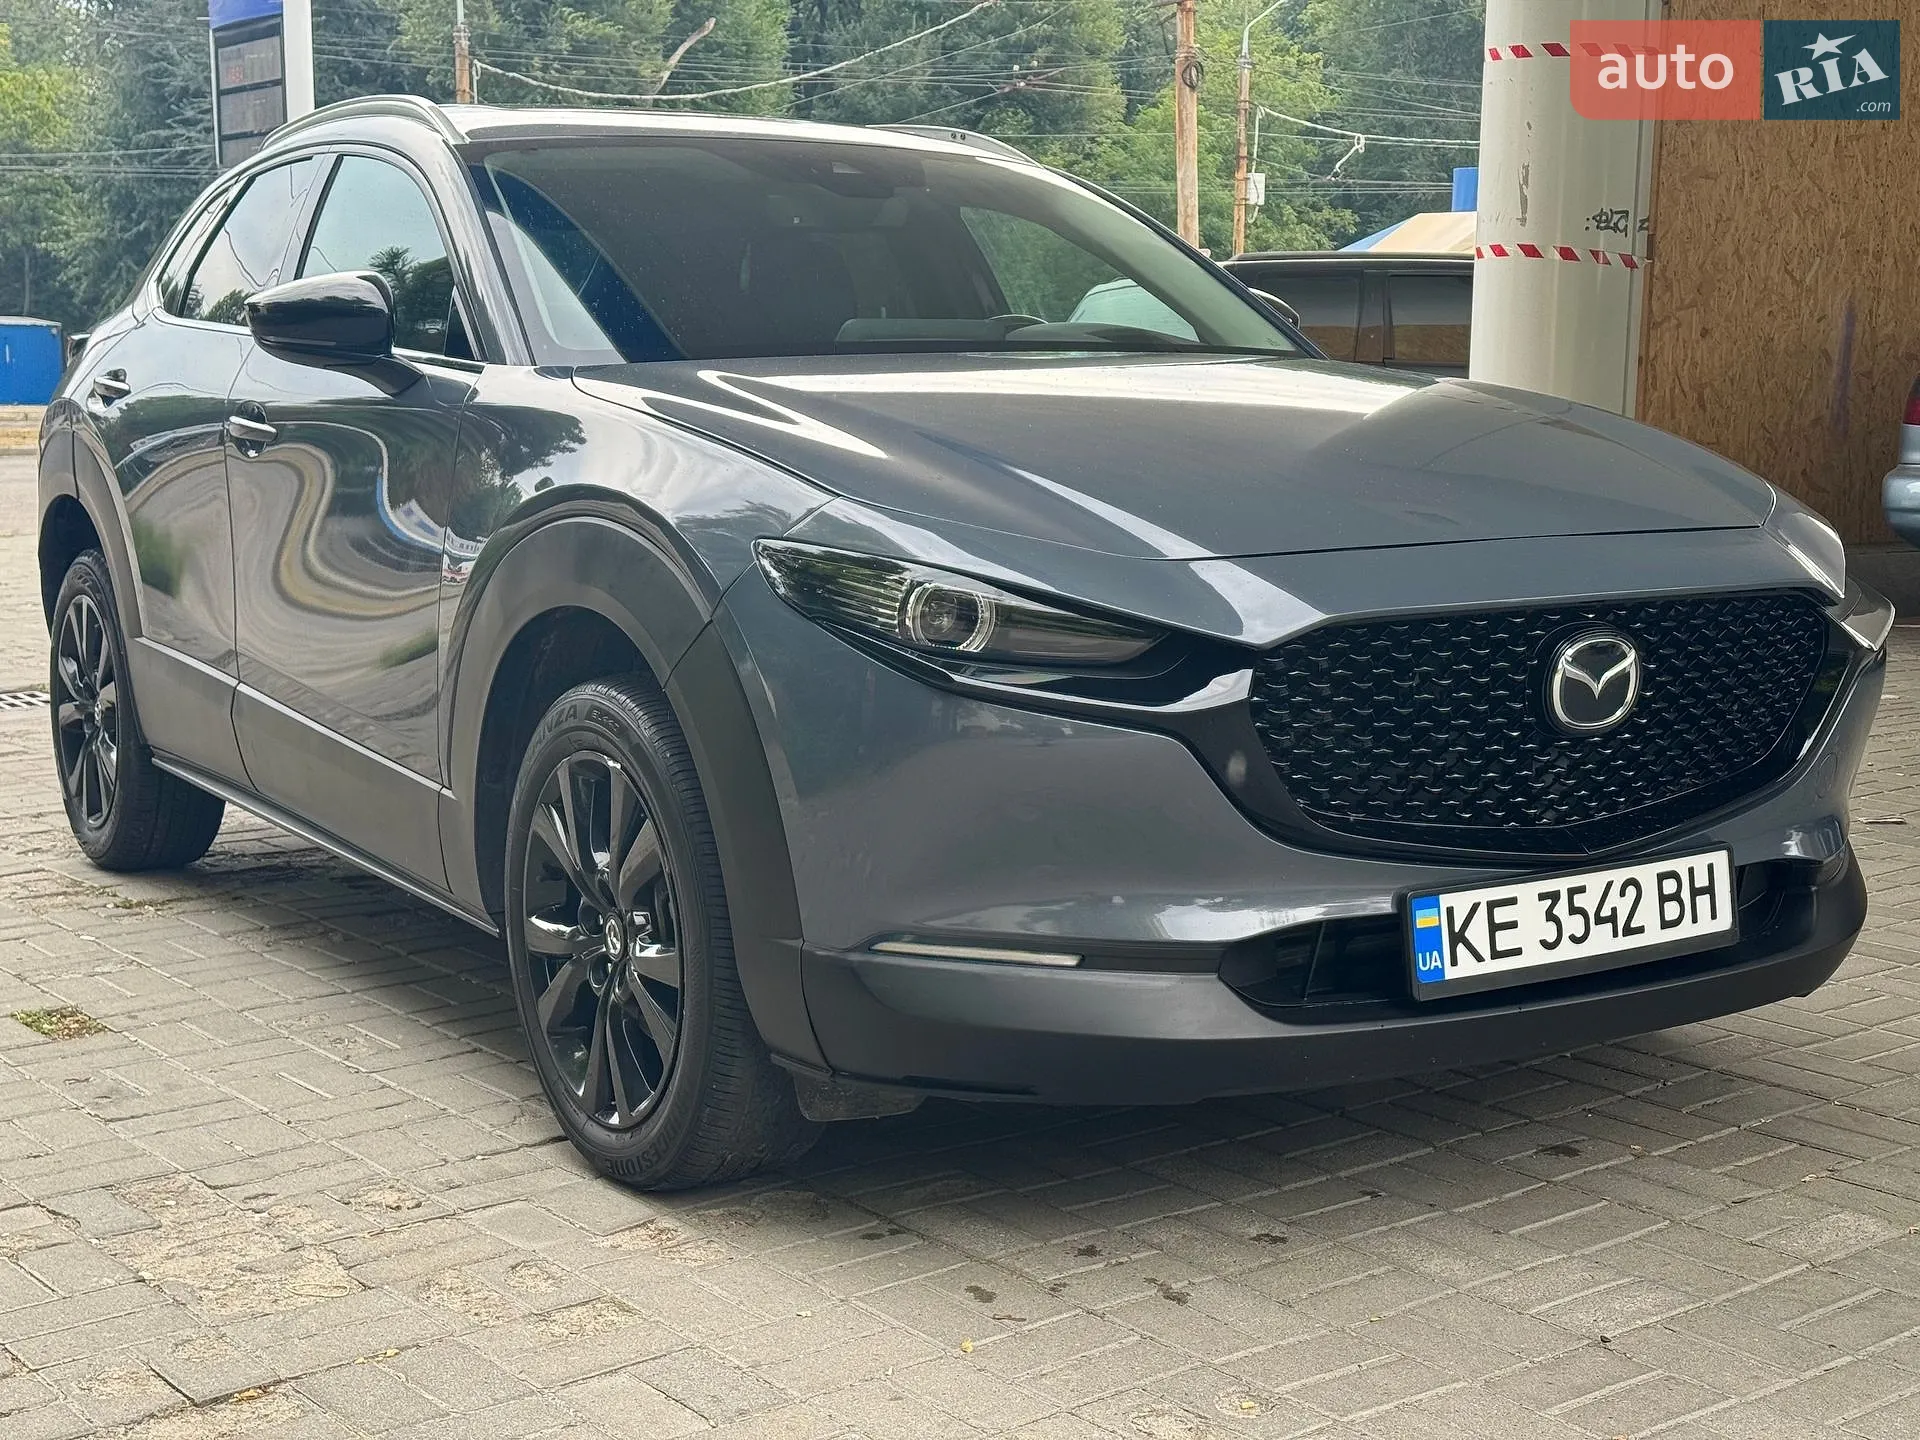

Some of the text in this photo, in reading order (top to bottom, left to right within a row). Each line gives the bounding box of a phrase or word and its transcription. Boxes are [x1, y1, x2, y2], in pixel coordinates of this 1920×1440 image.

[1445, 862, 1719, 968] KE 3542 BH
[1418, 952, 1443, 972] UA
